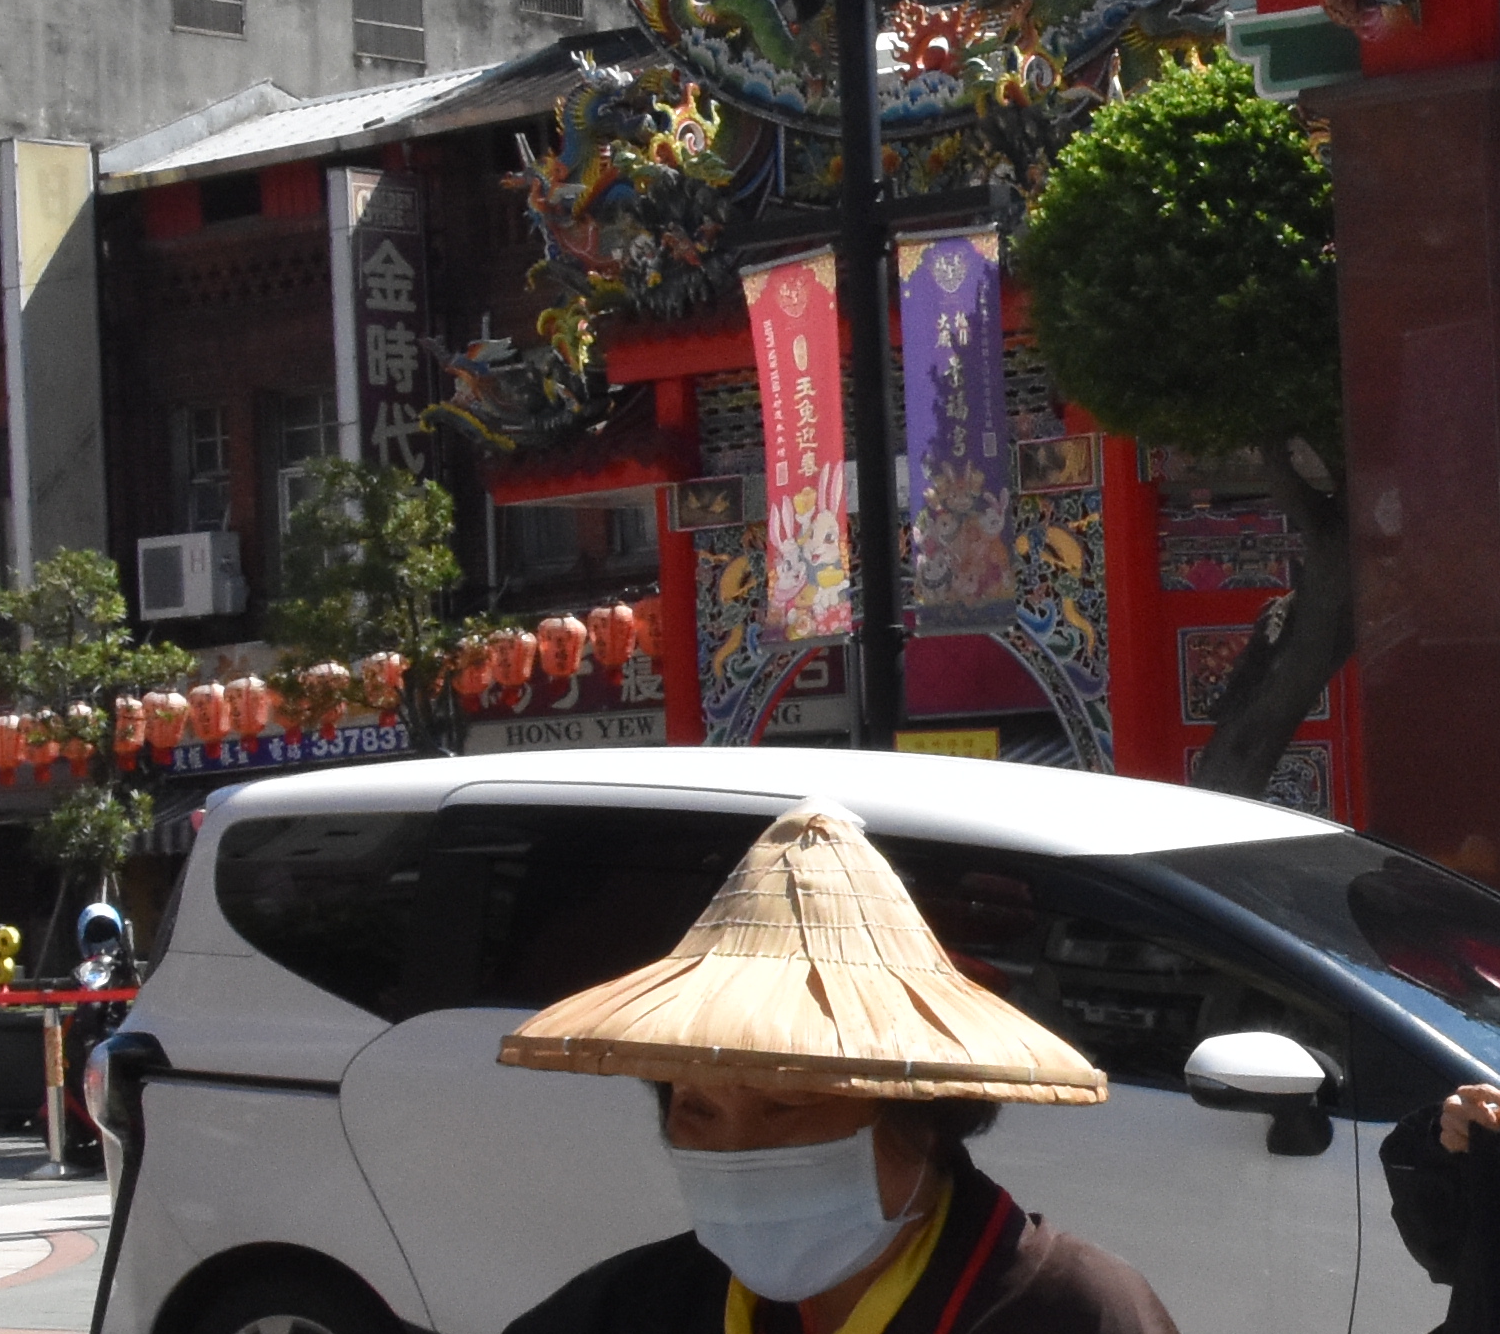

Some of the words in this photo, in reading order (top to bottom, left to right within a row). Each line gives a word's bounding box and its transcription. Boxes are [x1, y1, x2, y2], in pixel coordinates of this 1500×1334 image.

[362, 238, 425, 476] 金時代
[794, 376, 818, 477] 玉兔迎春
[506, 722, 582, 747] HONG
[597, 716, 655, 739] YEW
